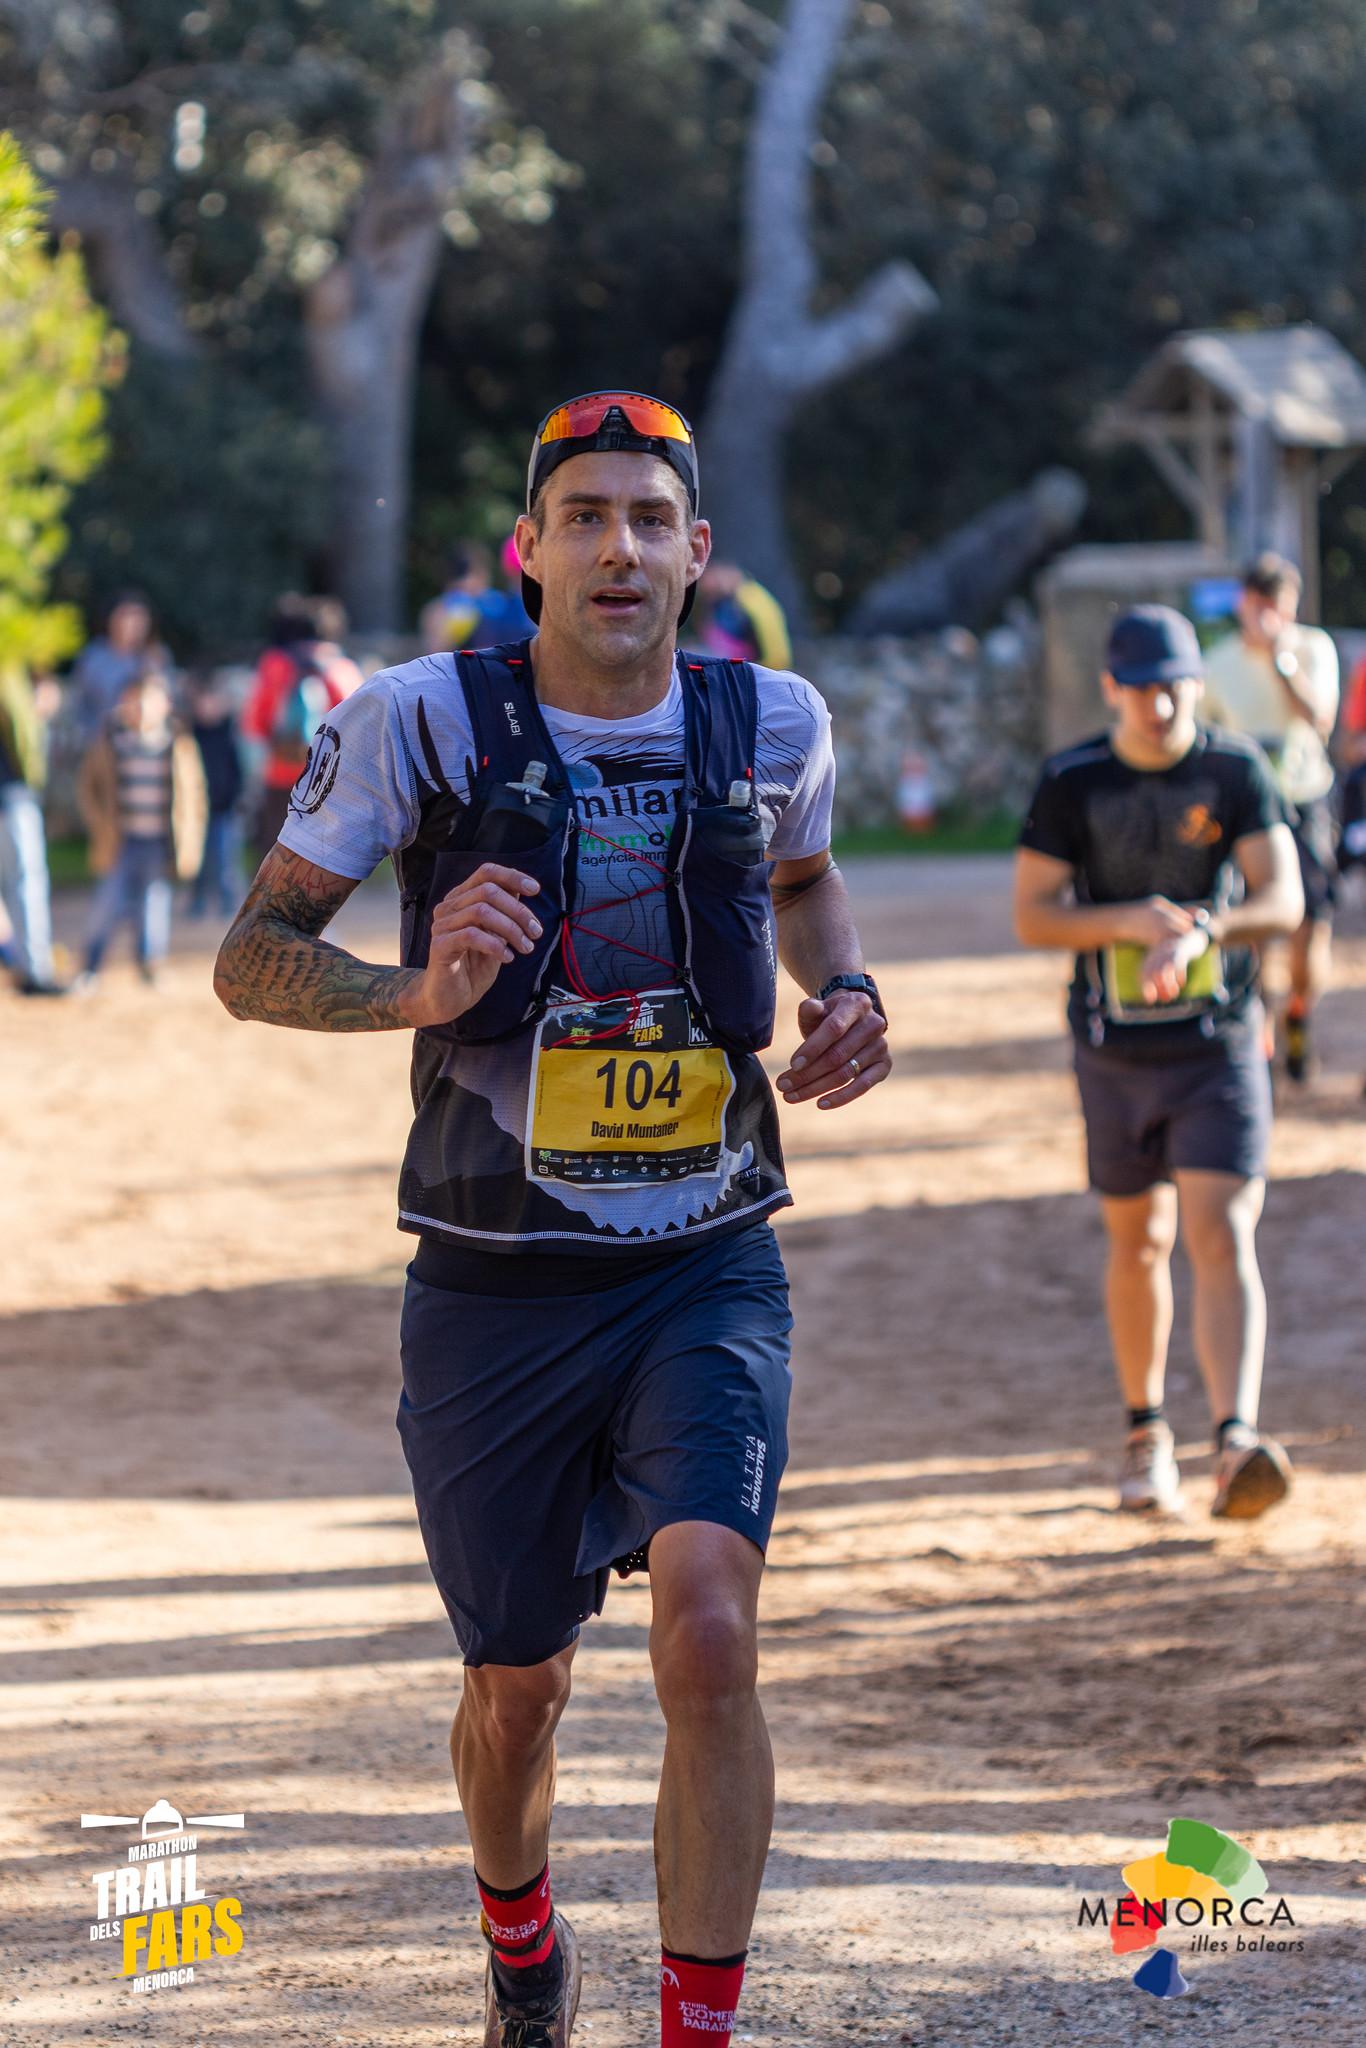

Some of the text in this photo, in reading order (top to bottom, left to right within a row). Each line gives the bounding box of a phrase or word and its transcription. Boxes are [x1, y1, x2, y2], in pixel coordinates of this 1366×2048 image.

[634, 1024, 663, 1043] FARS
[596, 1057, 682, 1111] 104
[591, 1121, 679, 1139] David Muntaner
[741, 1435, 756, 1508] ULTRA
[750, 1439, 767, 1516] SALOMON
